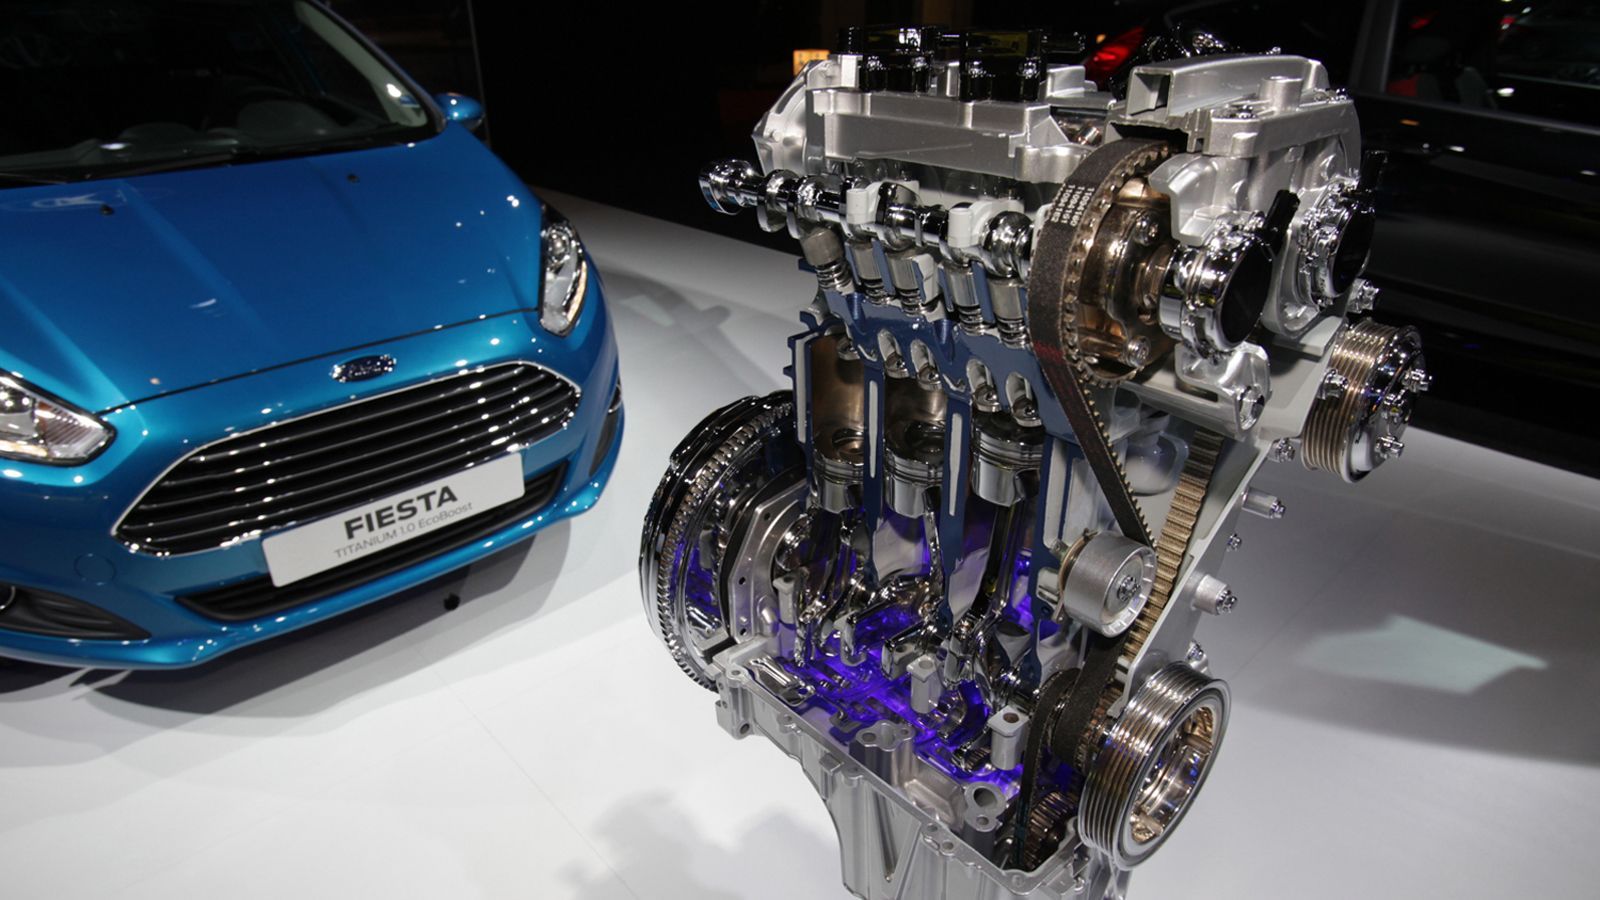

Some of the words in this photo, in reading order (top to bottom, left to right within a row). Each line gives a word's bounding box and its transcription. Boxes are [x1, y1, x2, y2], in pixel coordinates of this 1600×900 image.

[334, 530, 398, 558] TITANIUM
[419, 502, 473, 529] EcoBoost
[344, 486, 458, 540] FIESTA
